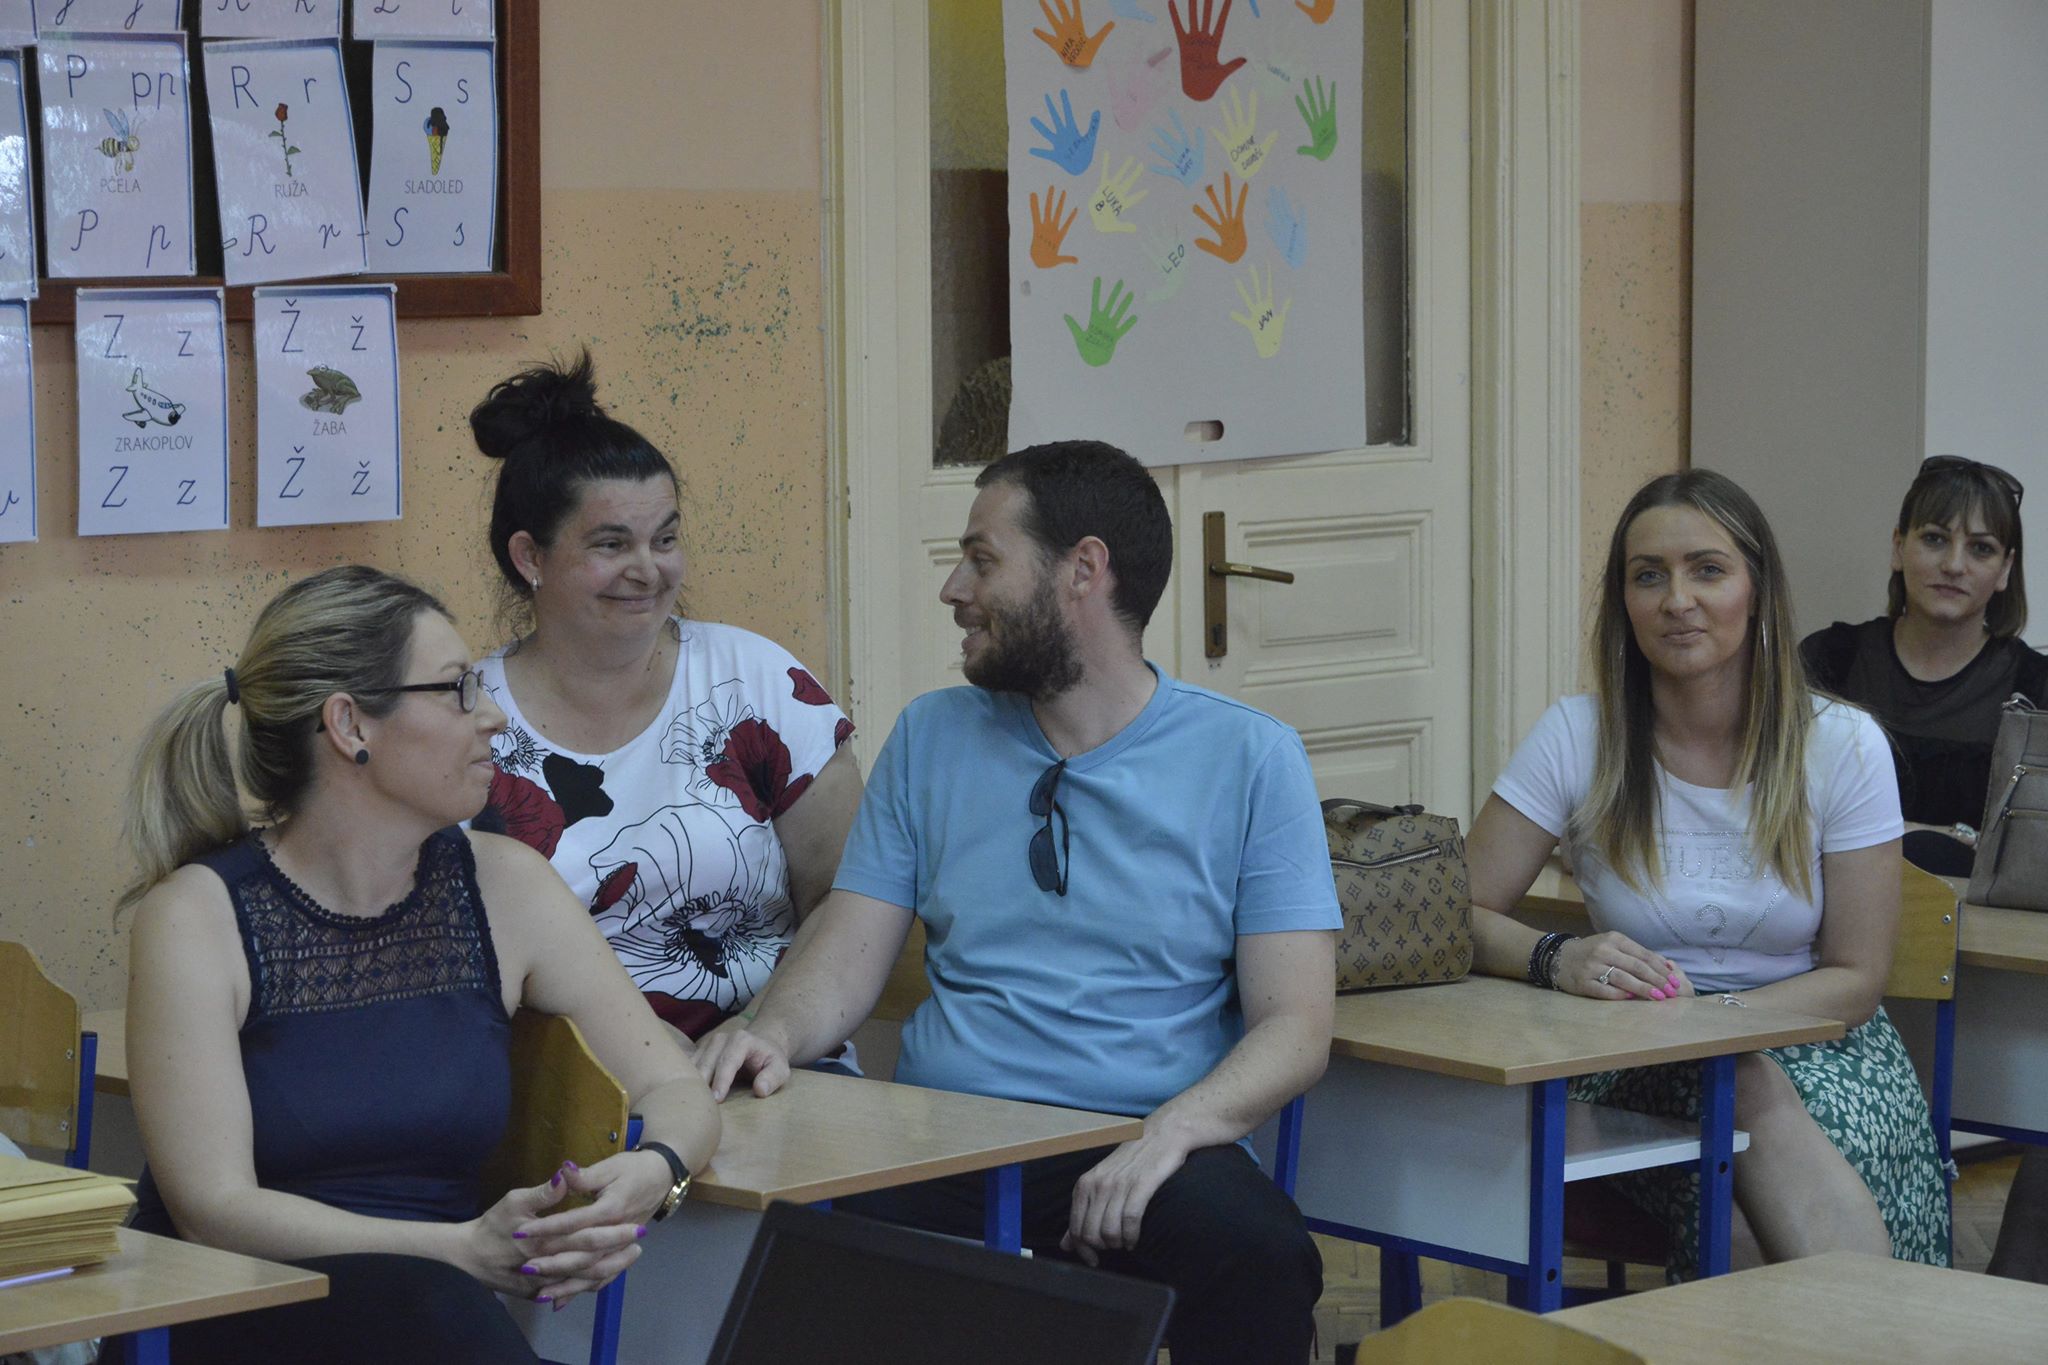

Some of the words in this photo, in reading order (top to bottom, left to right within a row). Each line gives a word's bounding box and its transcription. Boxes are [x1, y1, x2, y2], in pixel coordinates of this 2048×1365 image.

[67, 54, 87, 98] P
[230, 65, 259, 109] R
[303, 76, 317, 103] r
[394, 61, 412, 103] S
[457, 78, 469, 104] s
[100, 176, 142, 194] PČELA
[275, 180, 309, 199] RUŽA
[404, 179, 464, 195] SLADOLED
[70, 208, 99, 251] P
[242, 214, 277, 257] R
[385, 207, 409, 247] S
[1161, 243, 1184, 274] LEO
[103, 314, 128, 359] Z
[176, 330, 195, 357] z
[281, 299, 304, 353] Ž
[351, 315, 368, 351] ž
[114, 435, 194, 453] ZRAKOPLOV
[313, 418, 347, 436] ŽABA
[100, 465, 129, 508] Z
[176, 479, 198, 506] z
[278, 446, 306, 499] Ž
[350, 461, 371, 496] ž
